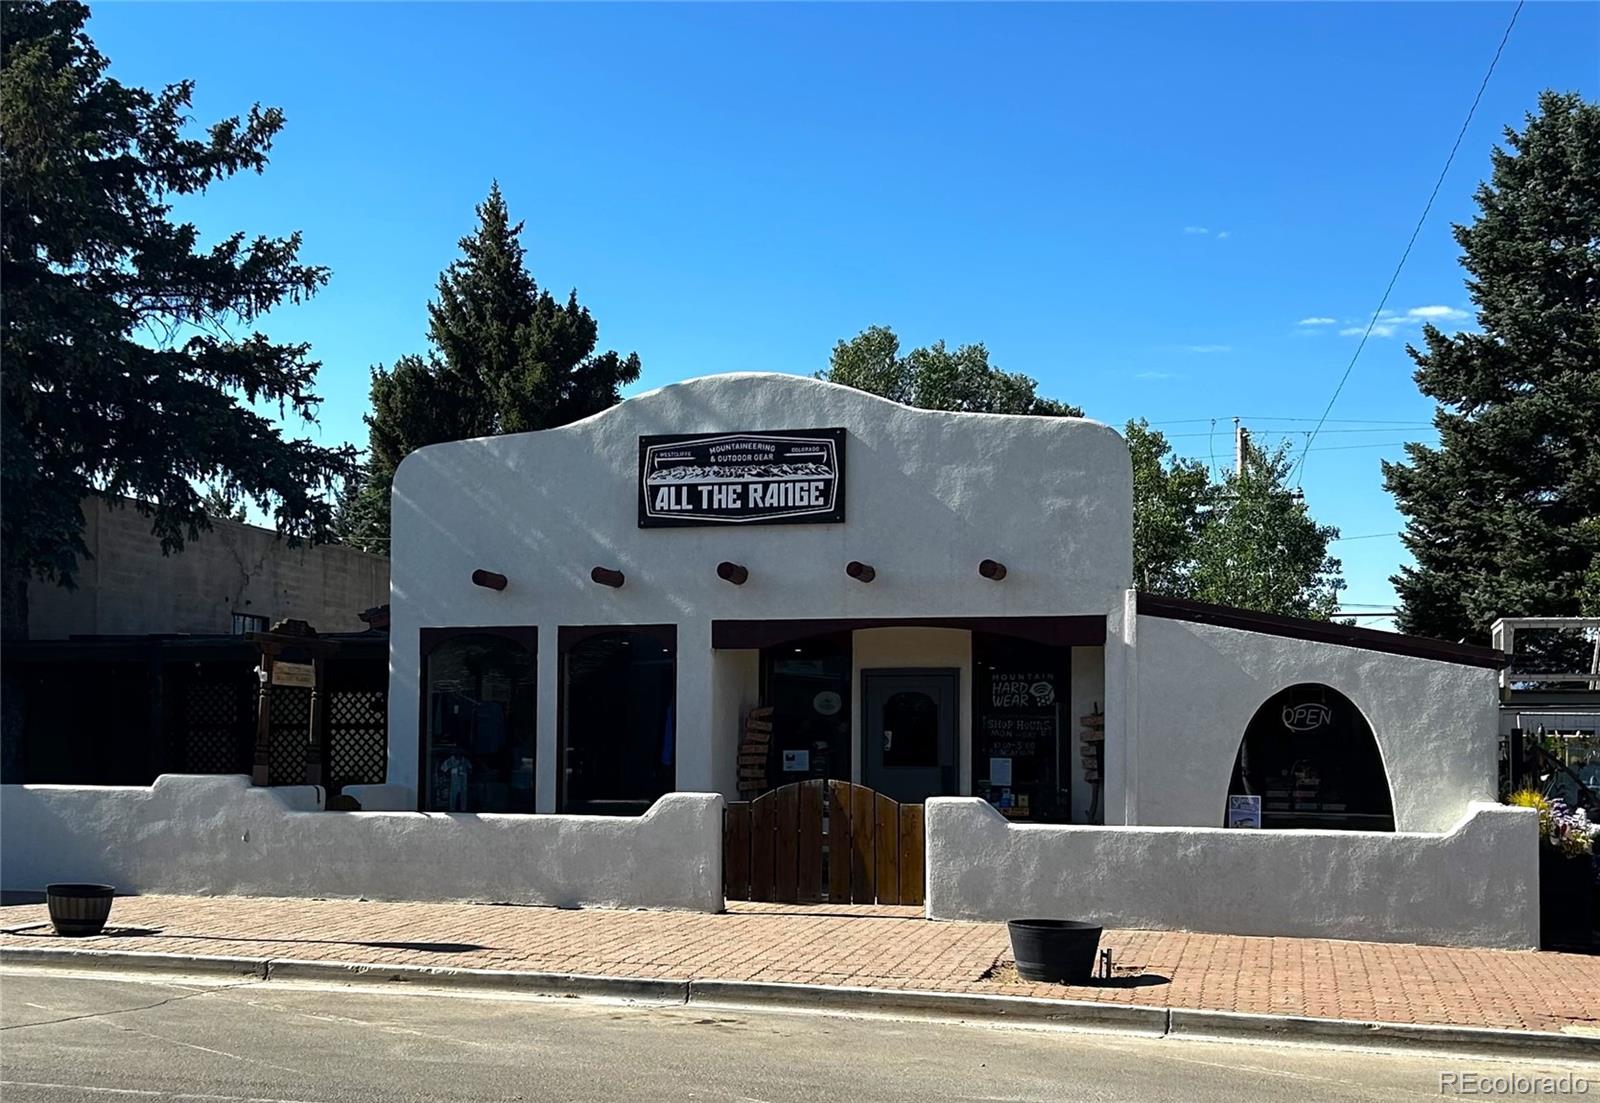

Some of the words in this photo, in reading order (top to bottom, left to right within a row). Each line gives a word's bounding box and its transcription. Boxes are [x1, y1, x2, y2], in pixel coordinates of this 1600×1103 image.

[709, 443, 776, 455] MOUNTAINEERING
[717, 454, 752, 462] OUTDOOR
[753, 453, 774, 461] GEAR
[655, 486, 693, 511] ALL
[698, 484, 742, 509] THE
[748, 481, 825, 508] RANGE
[992, 673, 1054, 681] MOUNTAIN
[992, 681, 1029, 695] HARD
[992, 694, 1029, 707] WEAR
[1282, 708, 1332, 725] OPEN
